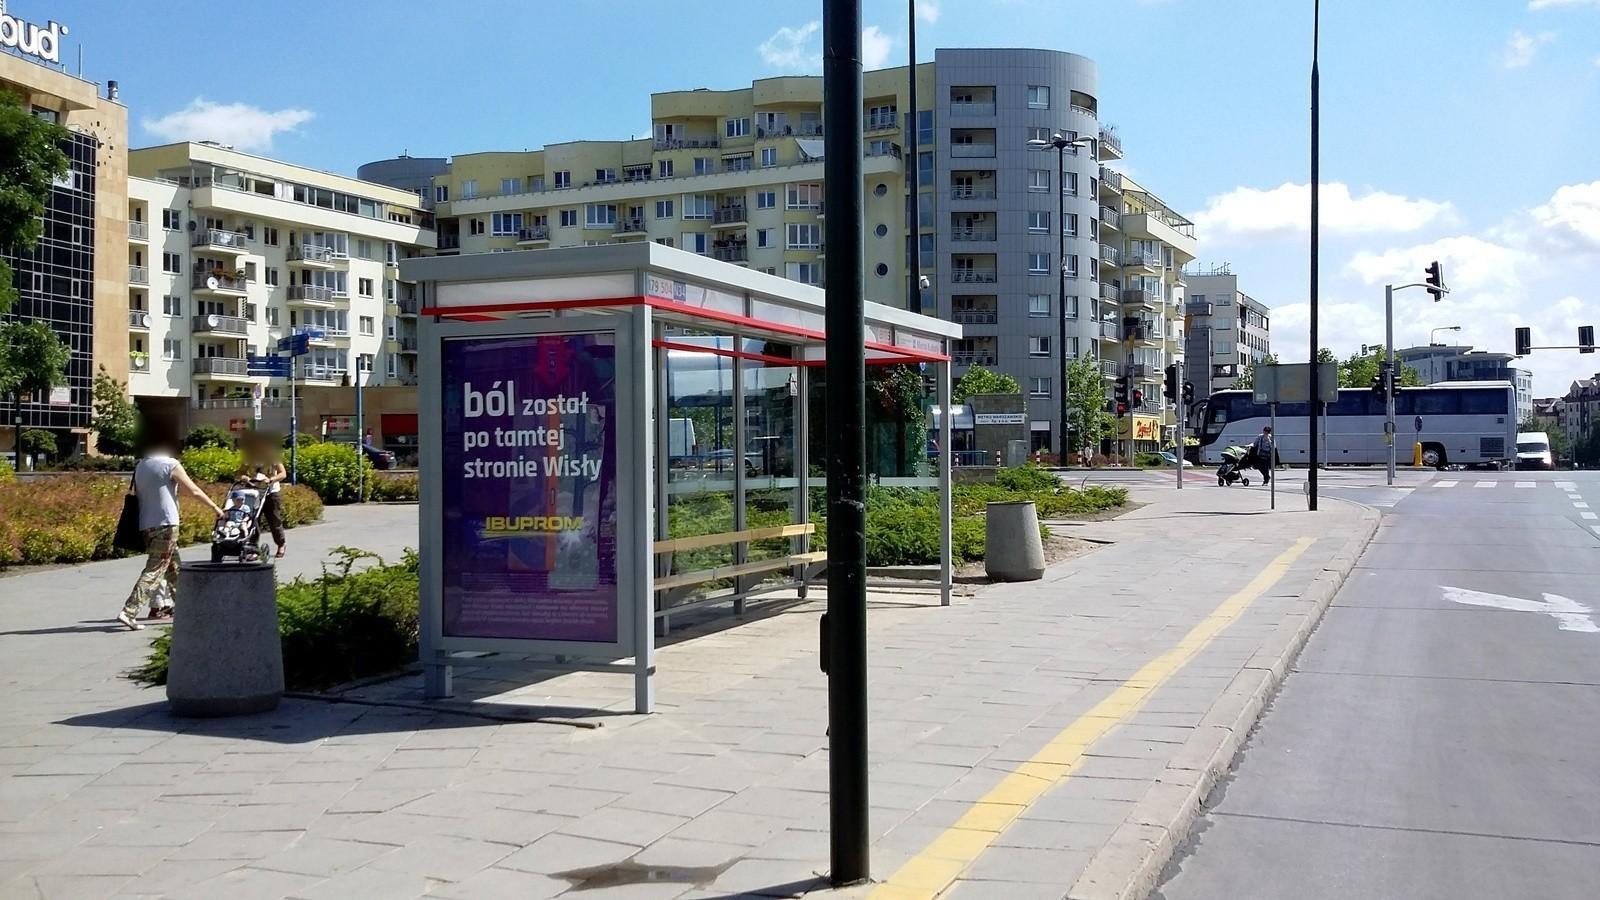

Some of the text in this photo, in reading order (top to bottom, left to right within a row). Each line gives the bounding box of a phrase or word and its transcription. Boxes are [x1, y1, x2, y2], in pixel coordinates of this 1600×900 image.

[464, 380, 589, 417] ból został
[464, 423, 564, 451] po tamtej
[464, 454, 602, 480] stronie Wisły
[486, 516, 584, 531] IBUPROM
